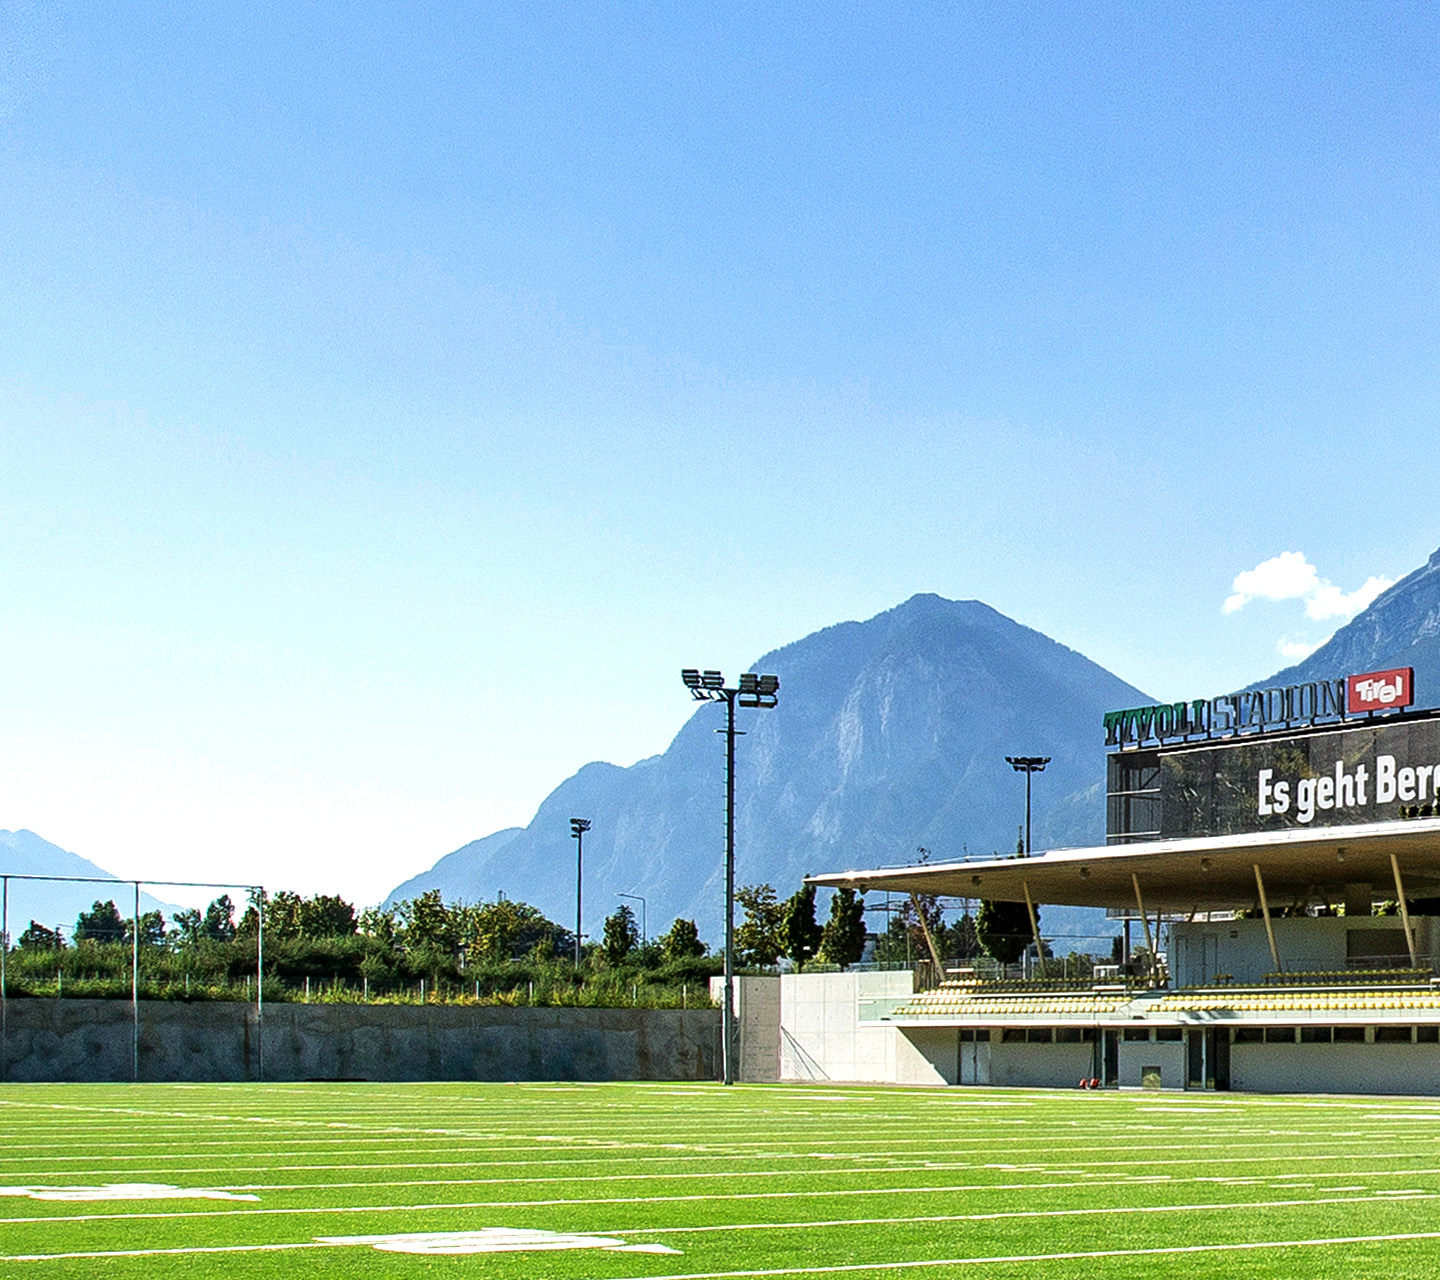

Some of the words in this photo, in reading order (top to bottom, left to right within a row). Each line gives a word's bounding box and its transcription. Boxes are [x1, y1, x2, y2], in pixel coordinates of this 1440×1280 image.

[1104, 699, 1205, 746] TIVOLI
[1210, 678, 1347, 732] STADION
[1355, 676, 1403, 703] Tirol
[1258, 769, 1290, 816] Es
[1297, 760, 1369, 824] geht
